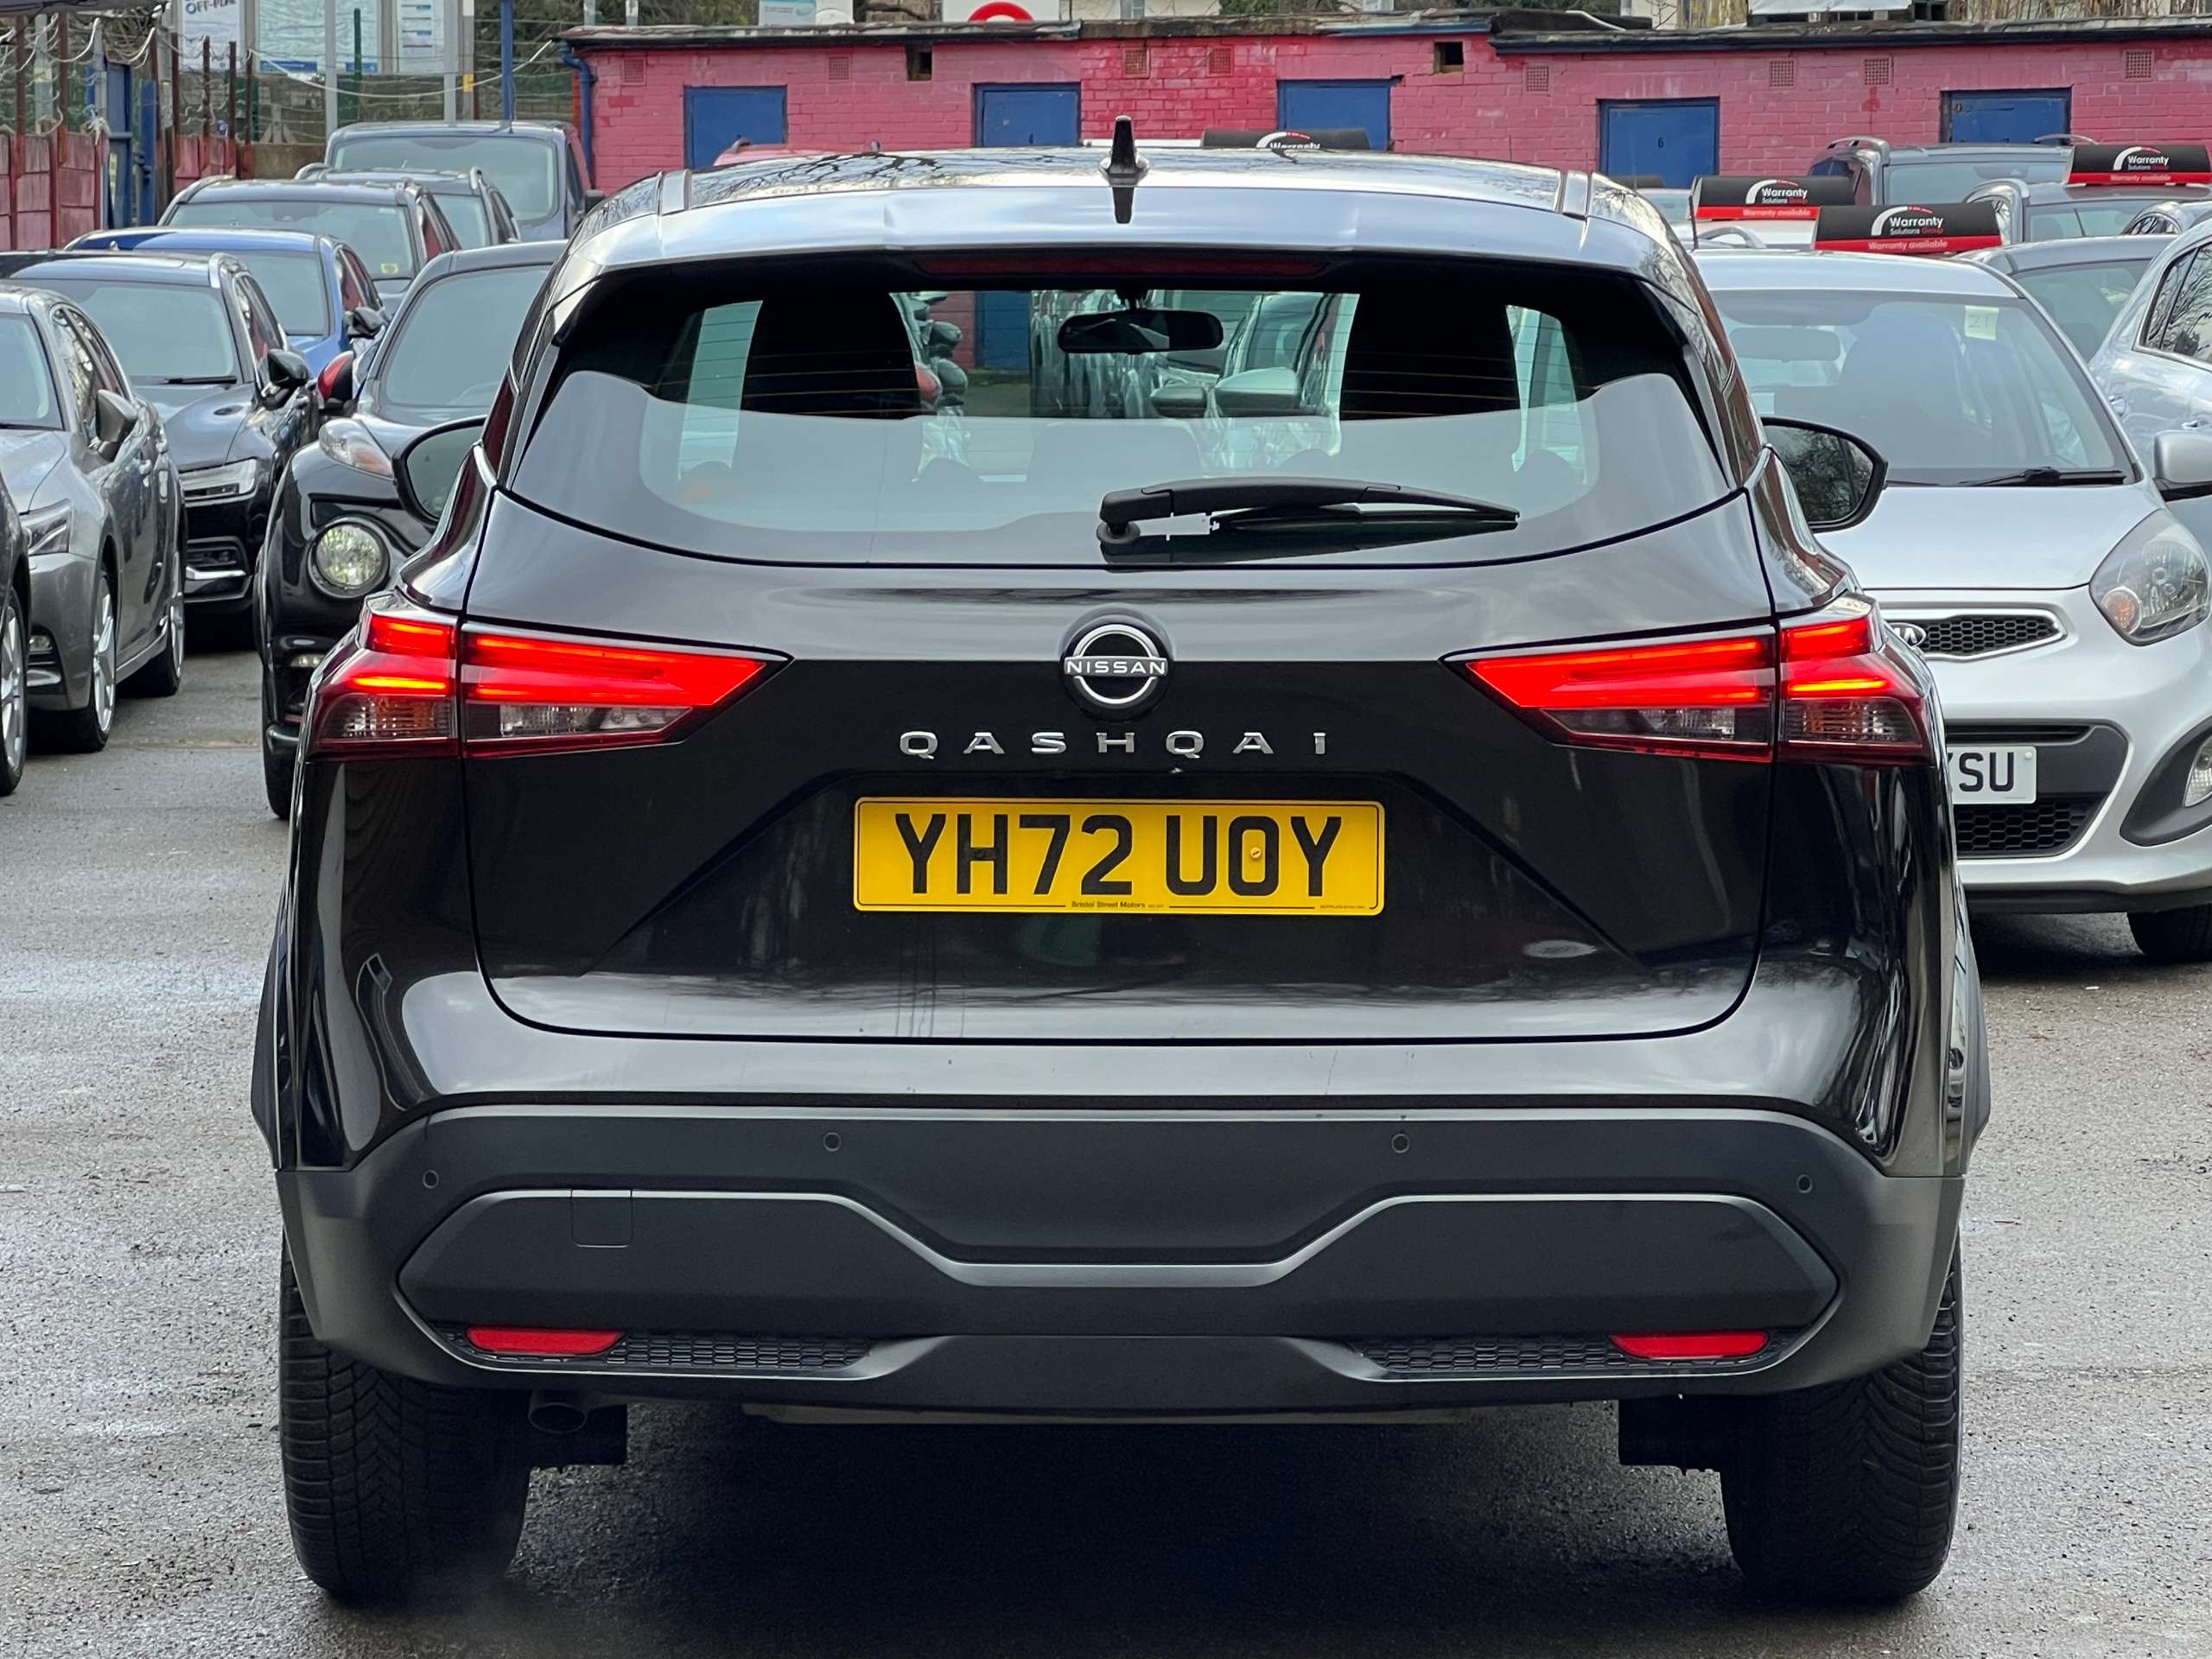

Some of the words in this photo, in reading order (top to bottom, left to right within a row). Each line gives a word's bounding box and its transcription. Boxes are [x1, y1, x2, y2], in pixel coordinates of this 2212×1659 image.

[2127, 156, 2170, 166] Warranty
[1762, 188, 1808, 199] Warranty
[1743, 208, 1777, 217] Warranty
[1777, 207, 1811, 216] available
[1889, 216, 1944, 228] Warranty
[1868, 241, 1907, 251] Warranty
[1909, 239, 1948, 249] available
[1066, 661, 1166, 674] NISSAN
[899, 730, 1326, 760] QASHQAI
[1947, 753, 2014, 791] SU
[895, 813, 1132, 895] YH72
[1166, 815, 1342, 897] UOY
